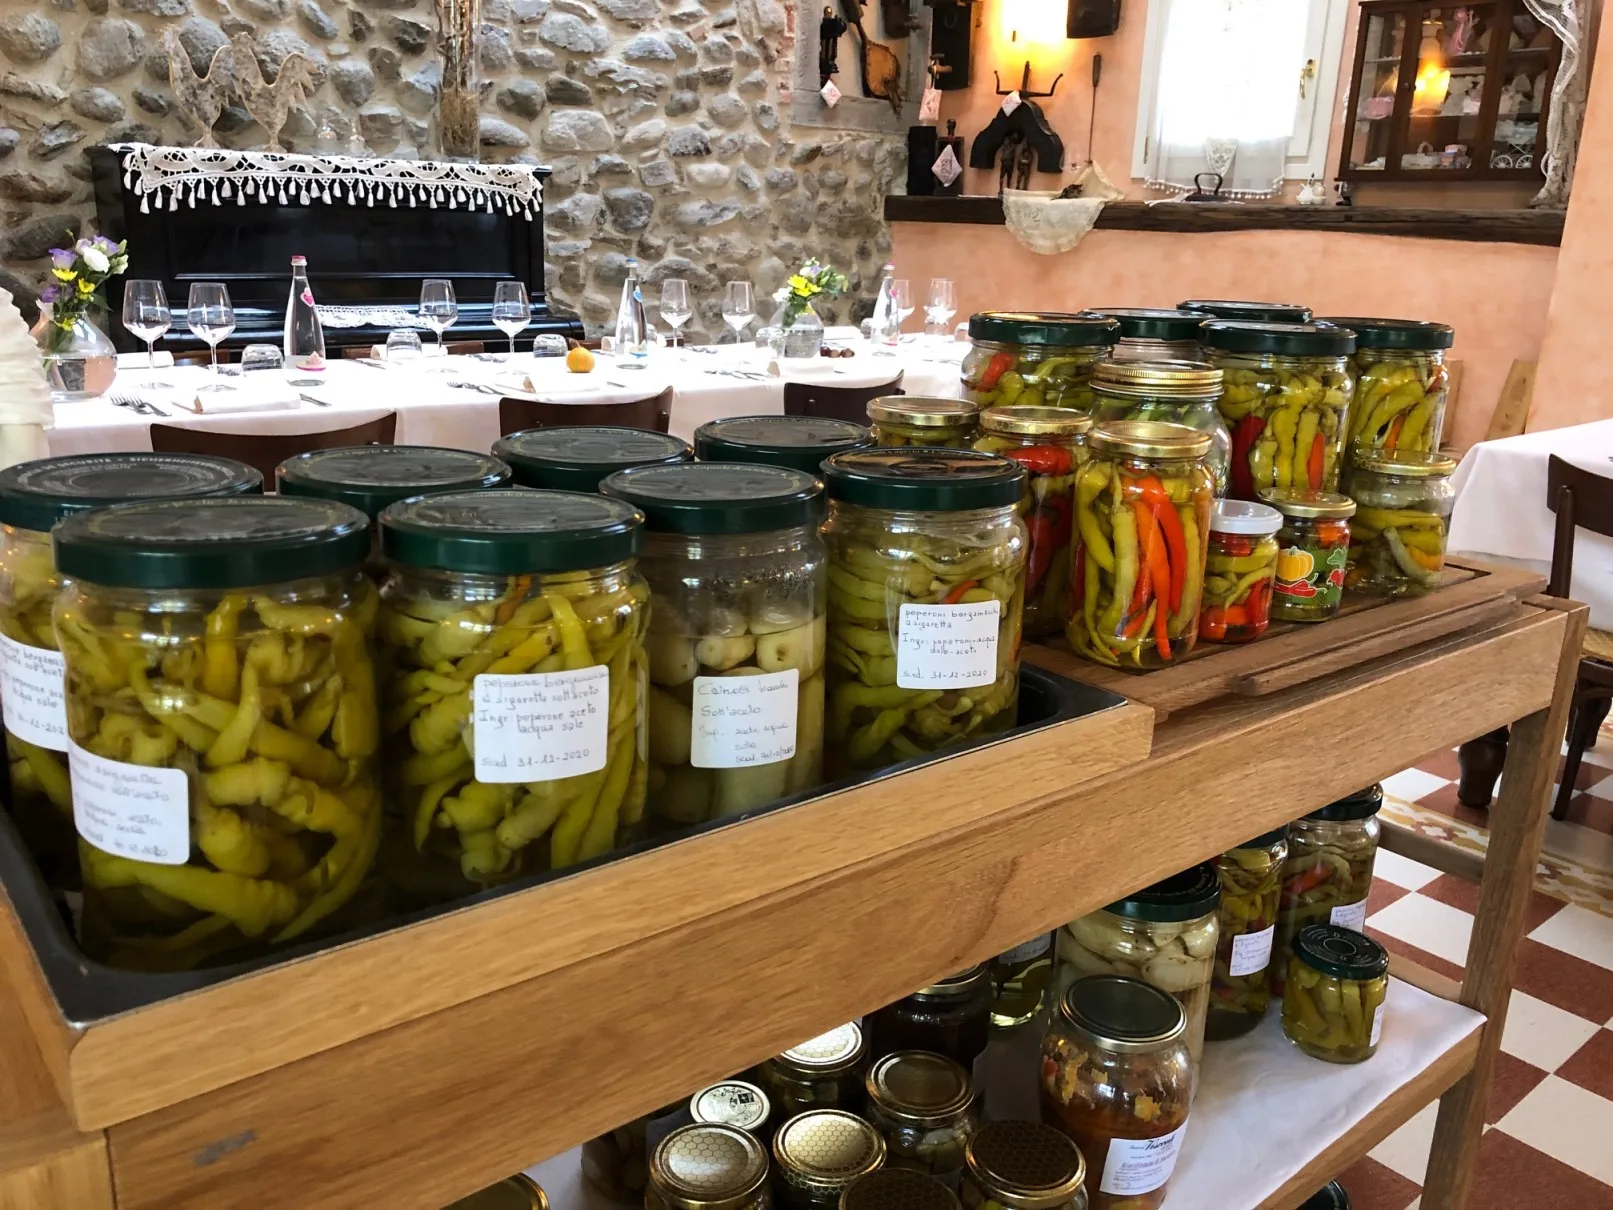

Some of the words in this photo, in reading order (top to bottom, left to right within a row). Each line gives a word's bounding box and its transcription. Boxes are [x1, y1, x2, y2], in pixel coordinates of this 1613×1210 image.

[930, 670, 988, 679] 31-12-2020
[570, 703, 597, 717] aceto
[562, 719, 584, 731] sale
[517, 749, 590, 767] 31-12-2020
